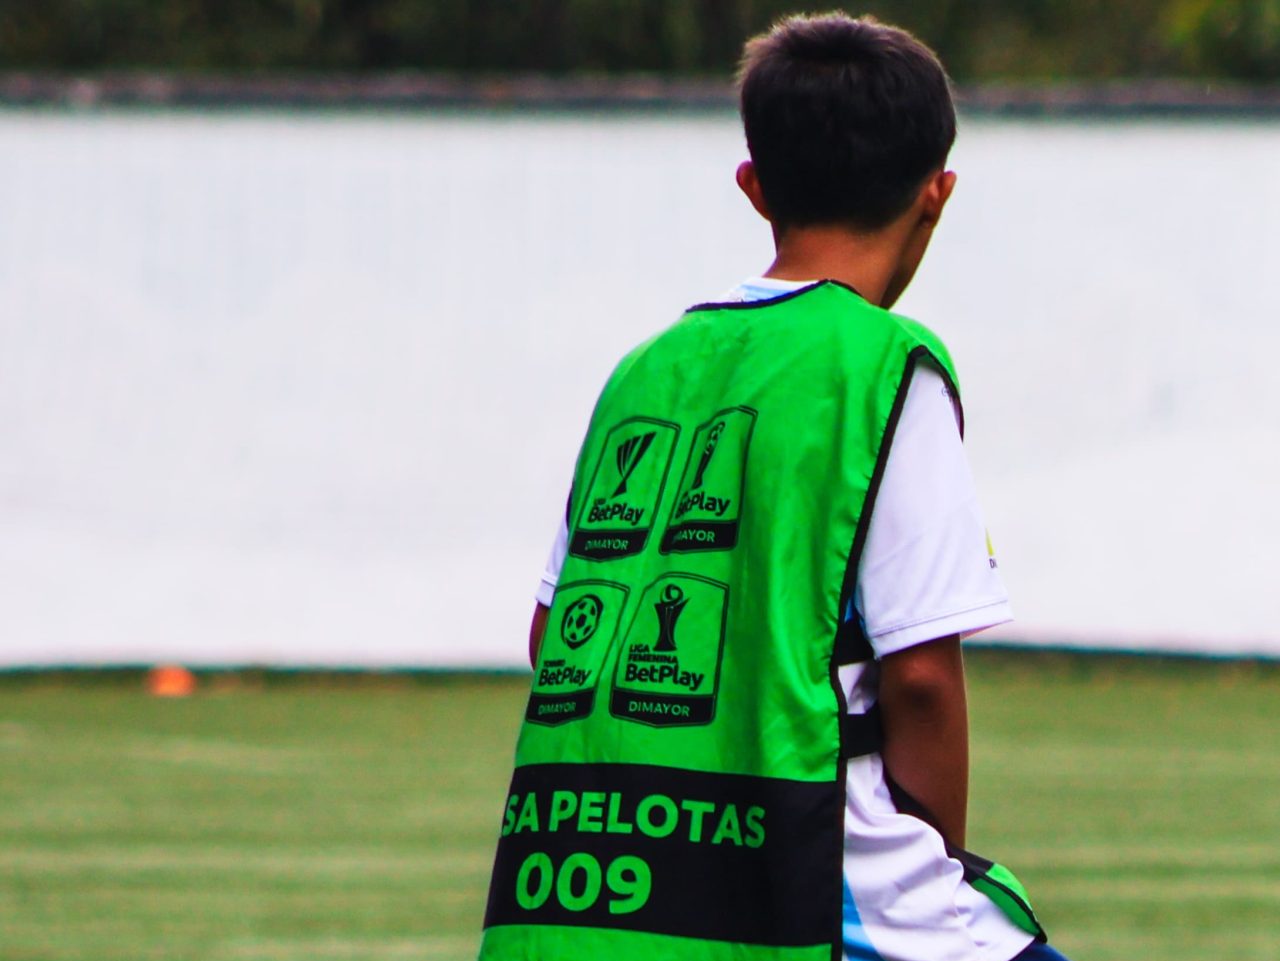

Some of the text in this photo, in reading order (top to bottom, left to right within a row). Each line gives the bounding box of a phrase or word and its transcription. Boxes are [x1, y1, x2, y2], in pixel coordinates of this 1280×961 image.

[587, 502, 644, 526] BetPlay
[628, 643, 650, 653] LIGA
[538, 665, 592, 687] BetPlay
[625, 663, 704, 691] BetPlay
[538, 701, 576, 716] DIMAYOR
[628, 700, 691, 717] DIMAYOR
[549, 790, 766, 848] PELOTAS
[515, 852, 652, 914] 009
